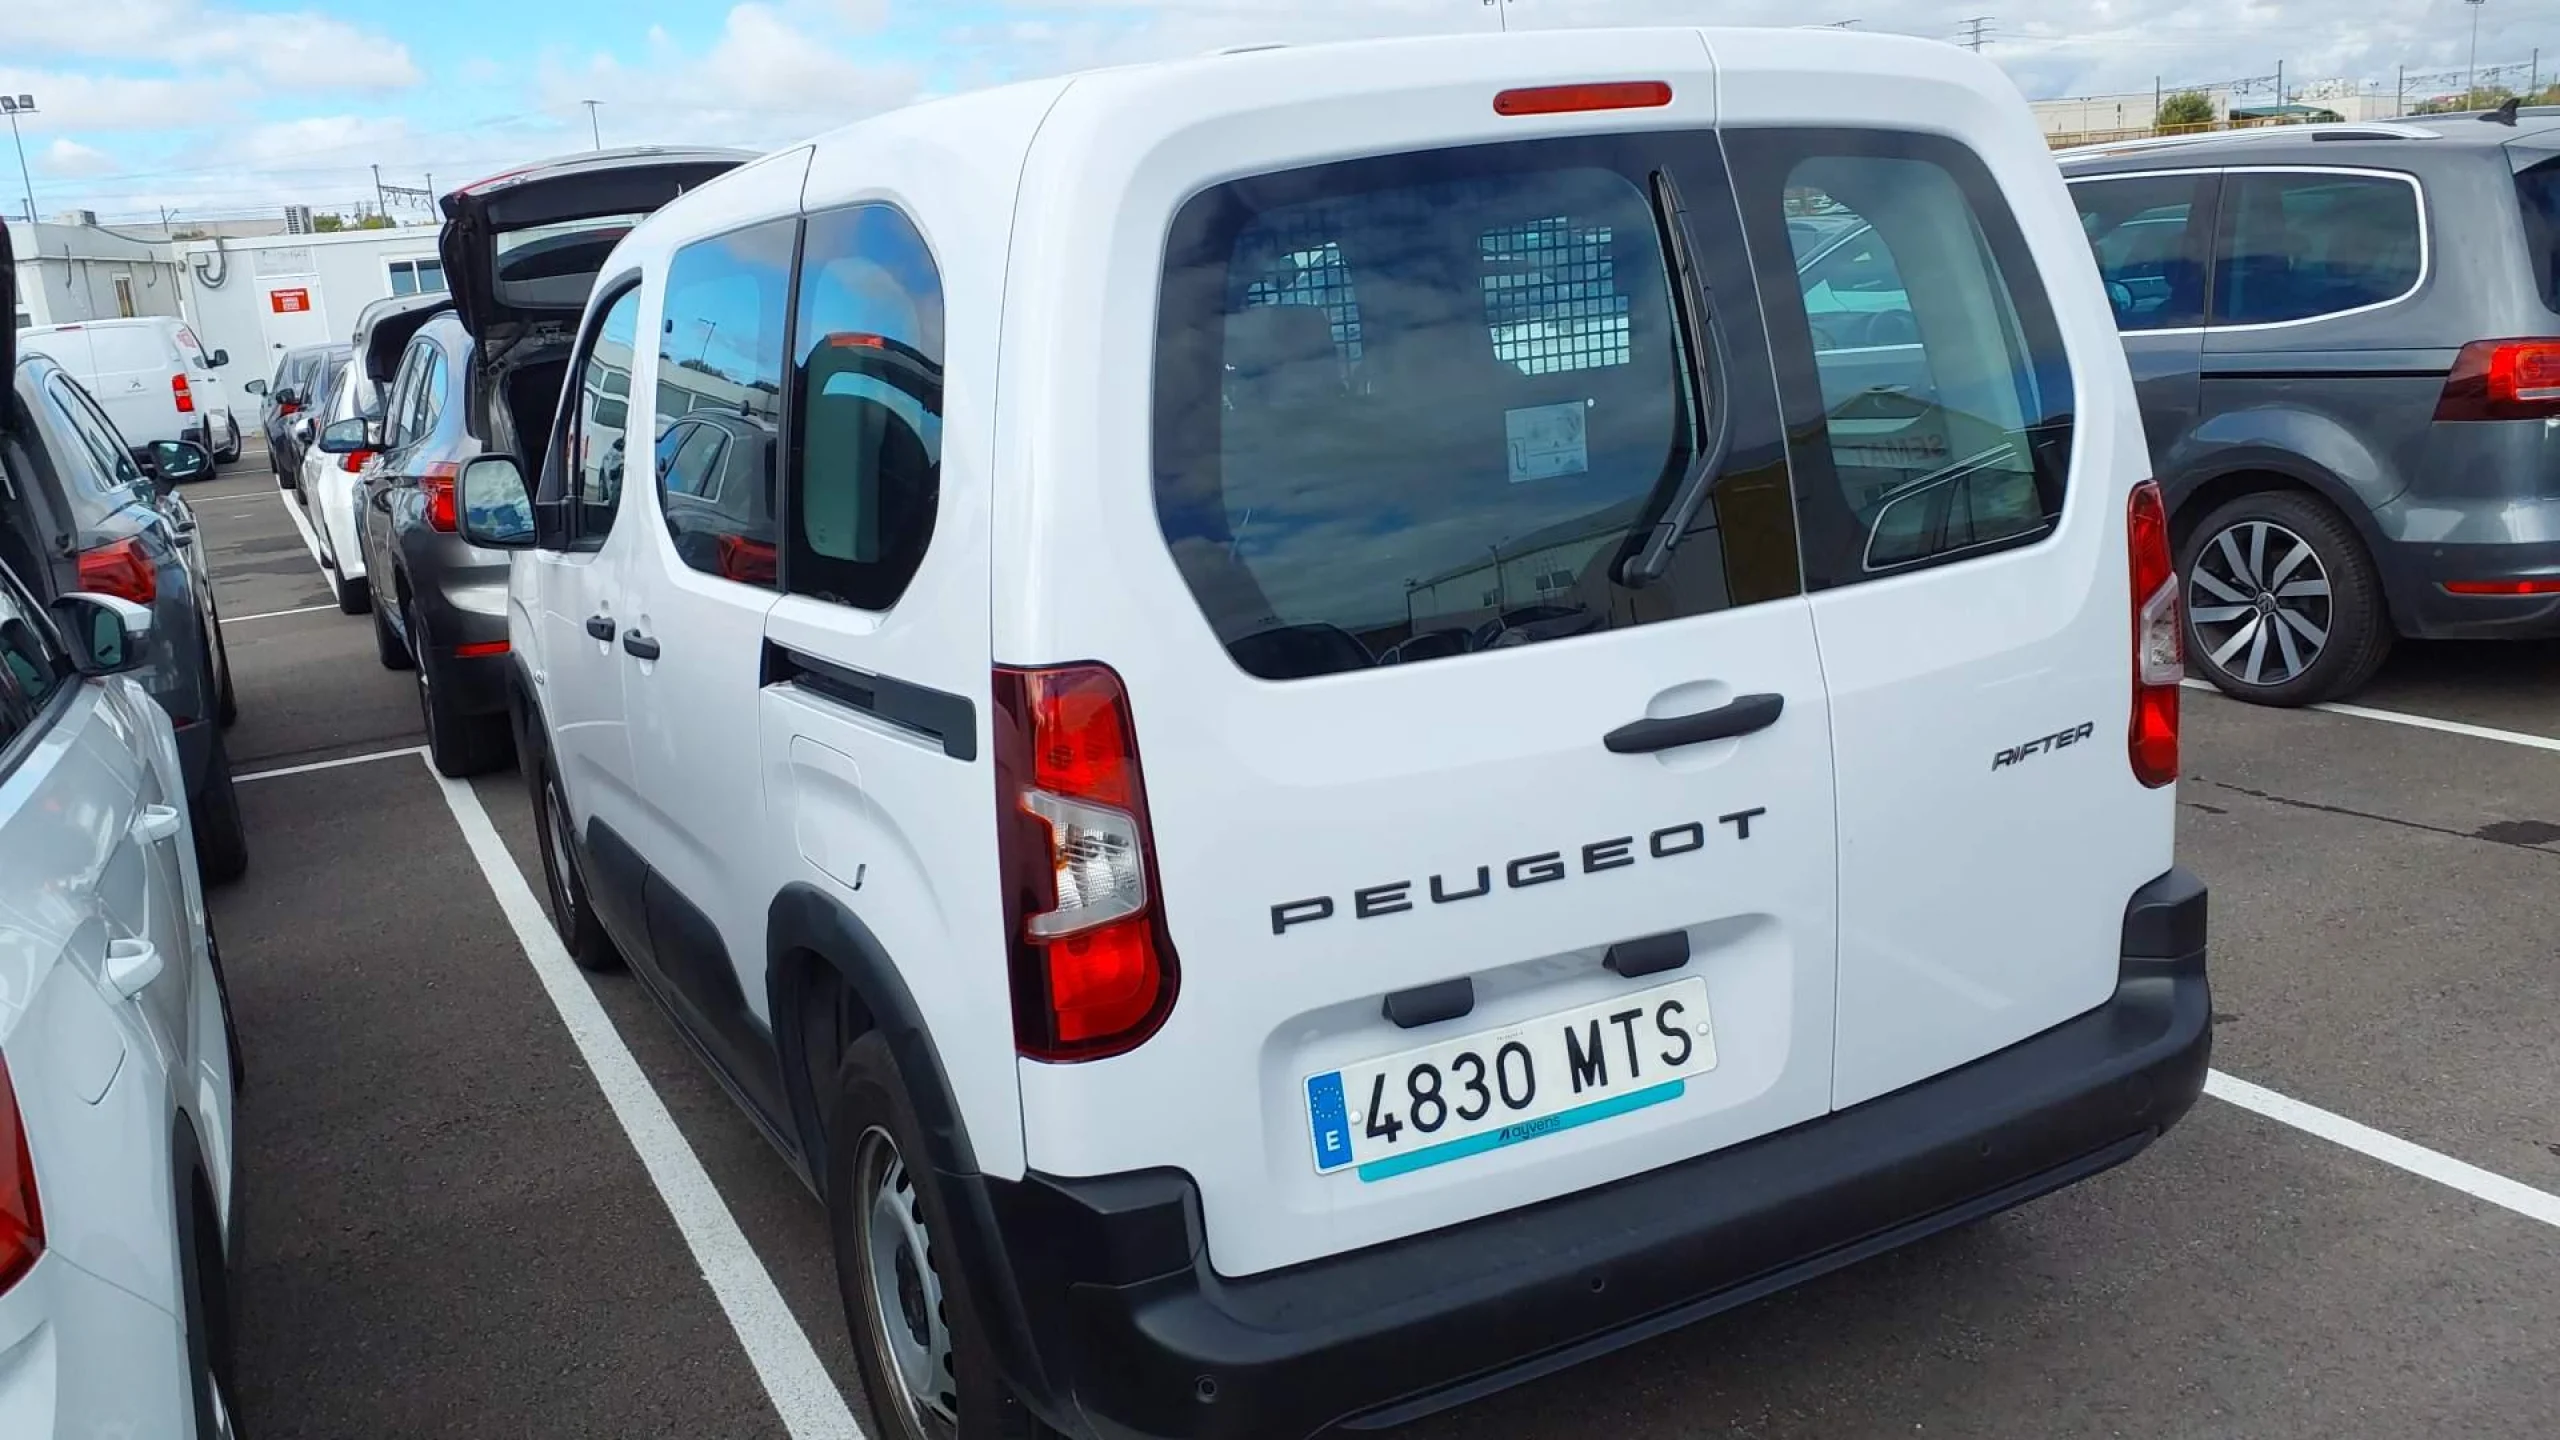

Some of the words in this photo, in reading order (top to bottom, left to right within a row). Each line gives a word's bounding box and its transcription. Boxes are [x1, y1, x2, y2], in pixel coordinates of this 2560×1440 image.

[1991, 719, 2094, 772] RIFTER
[1270, 806, 1766, 935] PEUGEOT
[1366, 1041, 1536, 1143] 4830
[1564, 999, 1693, 1094] MTS
[1325, 1130, 1341, 1151] E
[1511, 1115, 1561, 1140] ayvens
